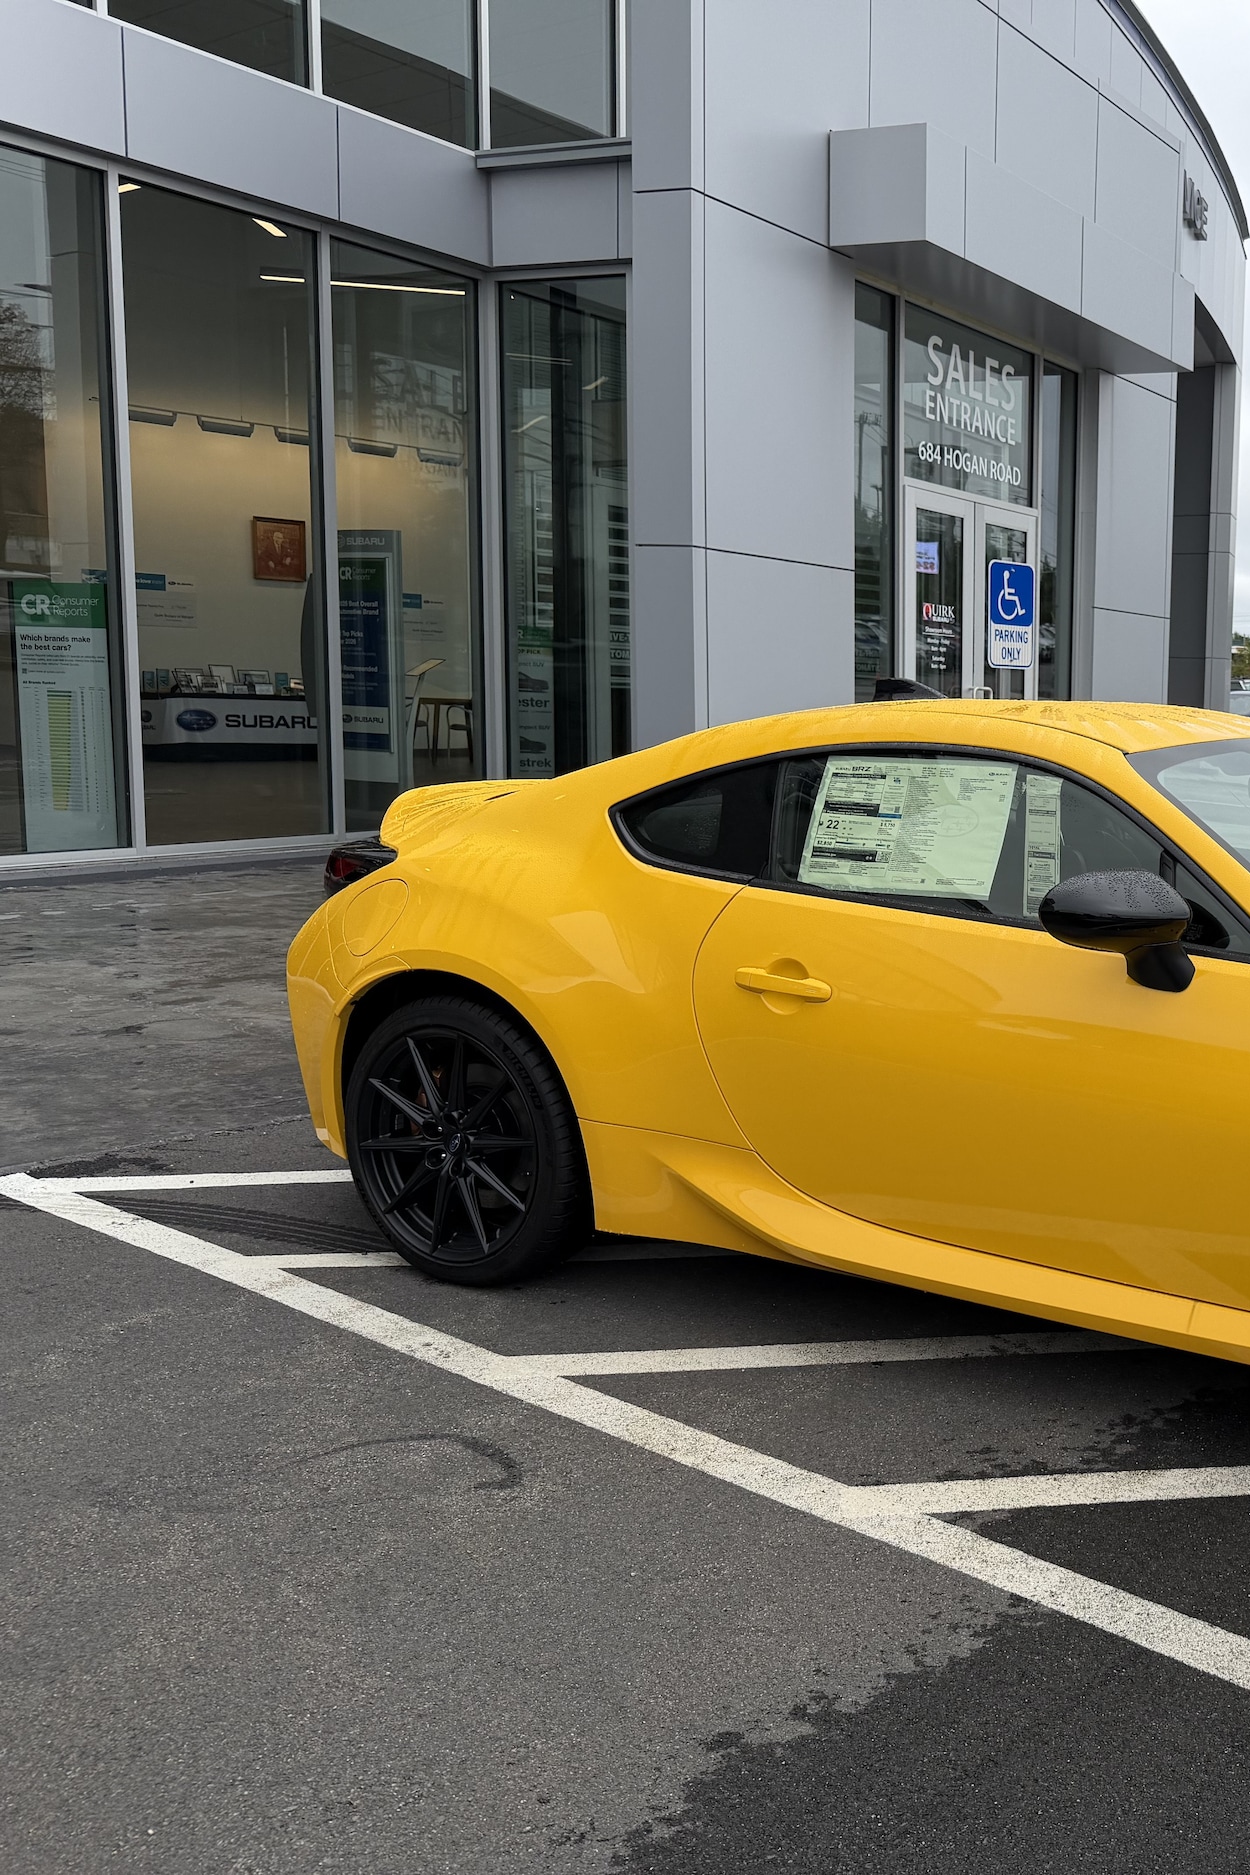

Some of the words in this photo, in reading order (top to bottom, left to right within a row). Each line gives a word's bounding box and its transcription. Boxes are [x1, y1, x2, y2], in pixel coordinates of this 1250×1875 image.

[927, 335, 1016, 412] SALES
[925, 389, 1016, 446] ENTRANCE
[918, 441, 942, 465] 684
[944, 446, 987, 478] HOGAN
[990, 460, 1021, 486] ROAD
[346, 537, 385, 546] SUBARU
[20, 593, 51, 615] CR
[51, 594, 99, 606] Consumer
[53, 605, 88, 617] Reports
[922, 602, 955, 620] QUIRK
[20, 634, 43, 642] Which
[44, 634, 70, 643] brands
[71, 635, 91, 643] make
[994, 628, 1029, 644] PARKING
[20, 643, 33, 651] the
[34, 643, 51, 651] best
[1001, 646, 1022, 660] ONLY
[353, 715, 384, 724] SUBARU
[519, 757, 552, 768] strek
[826, 819, 840, 830] 22
